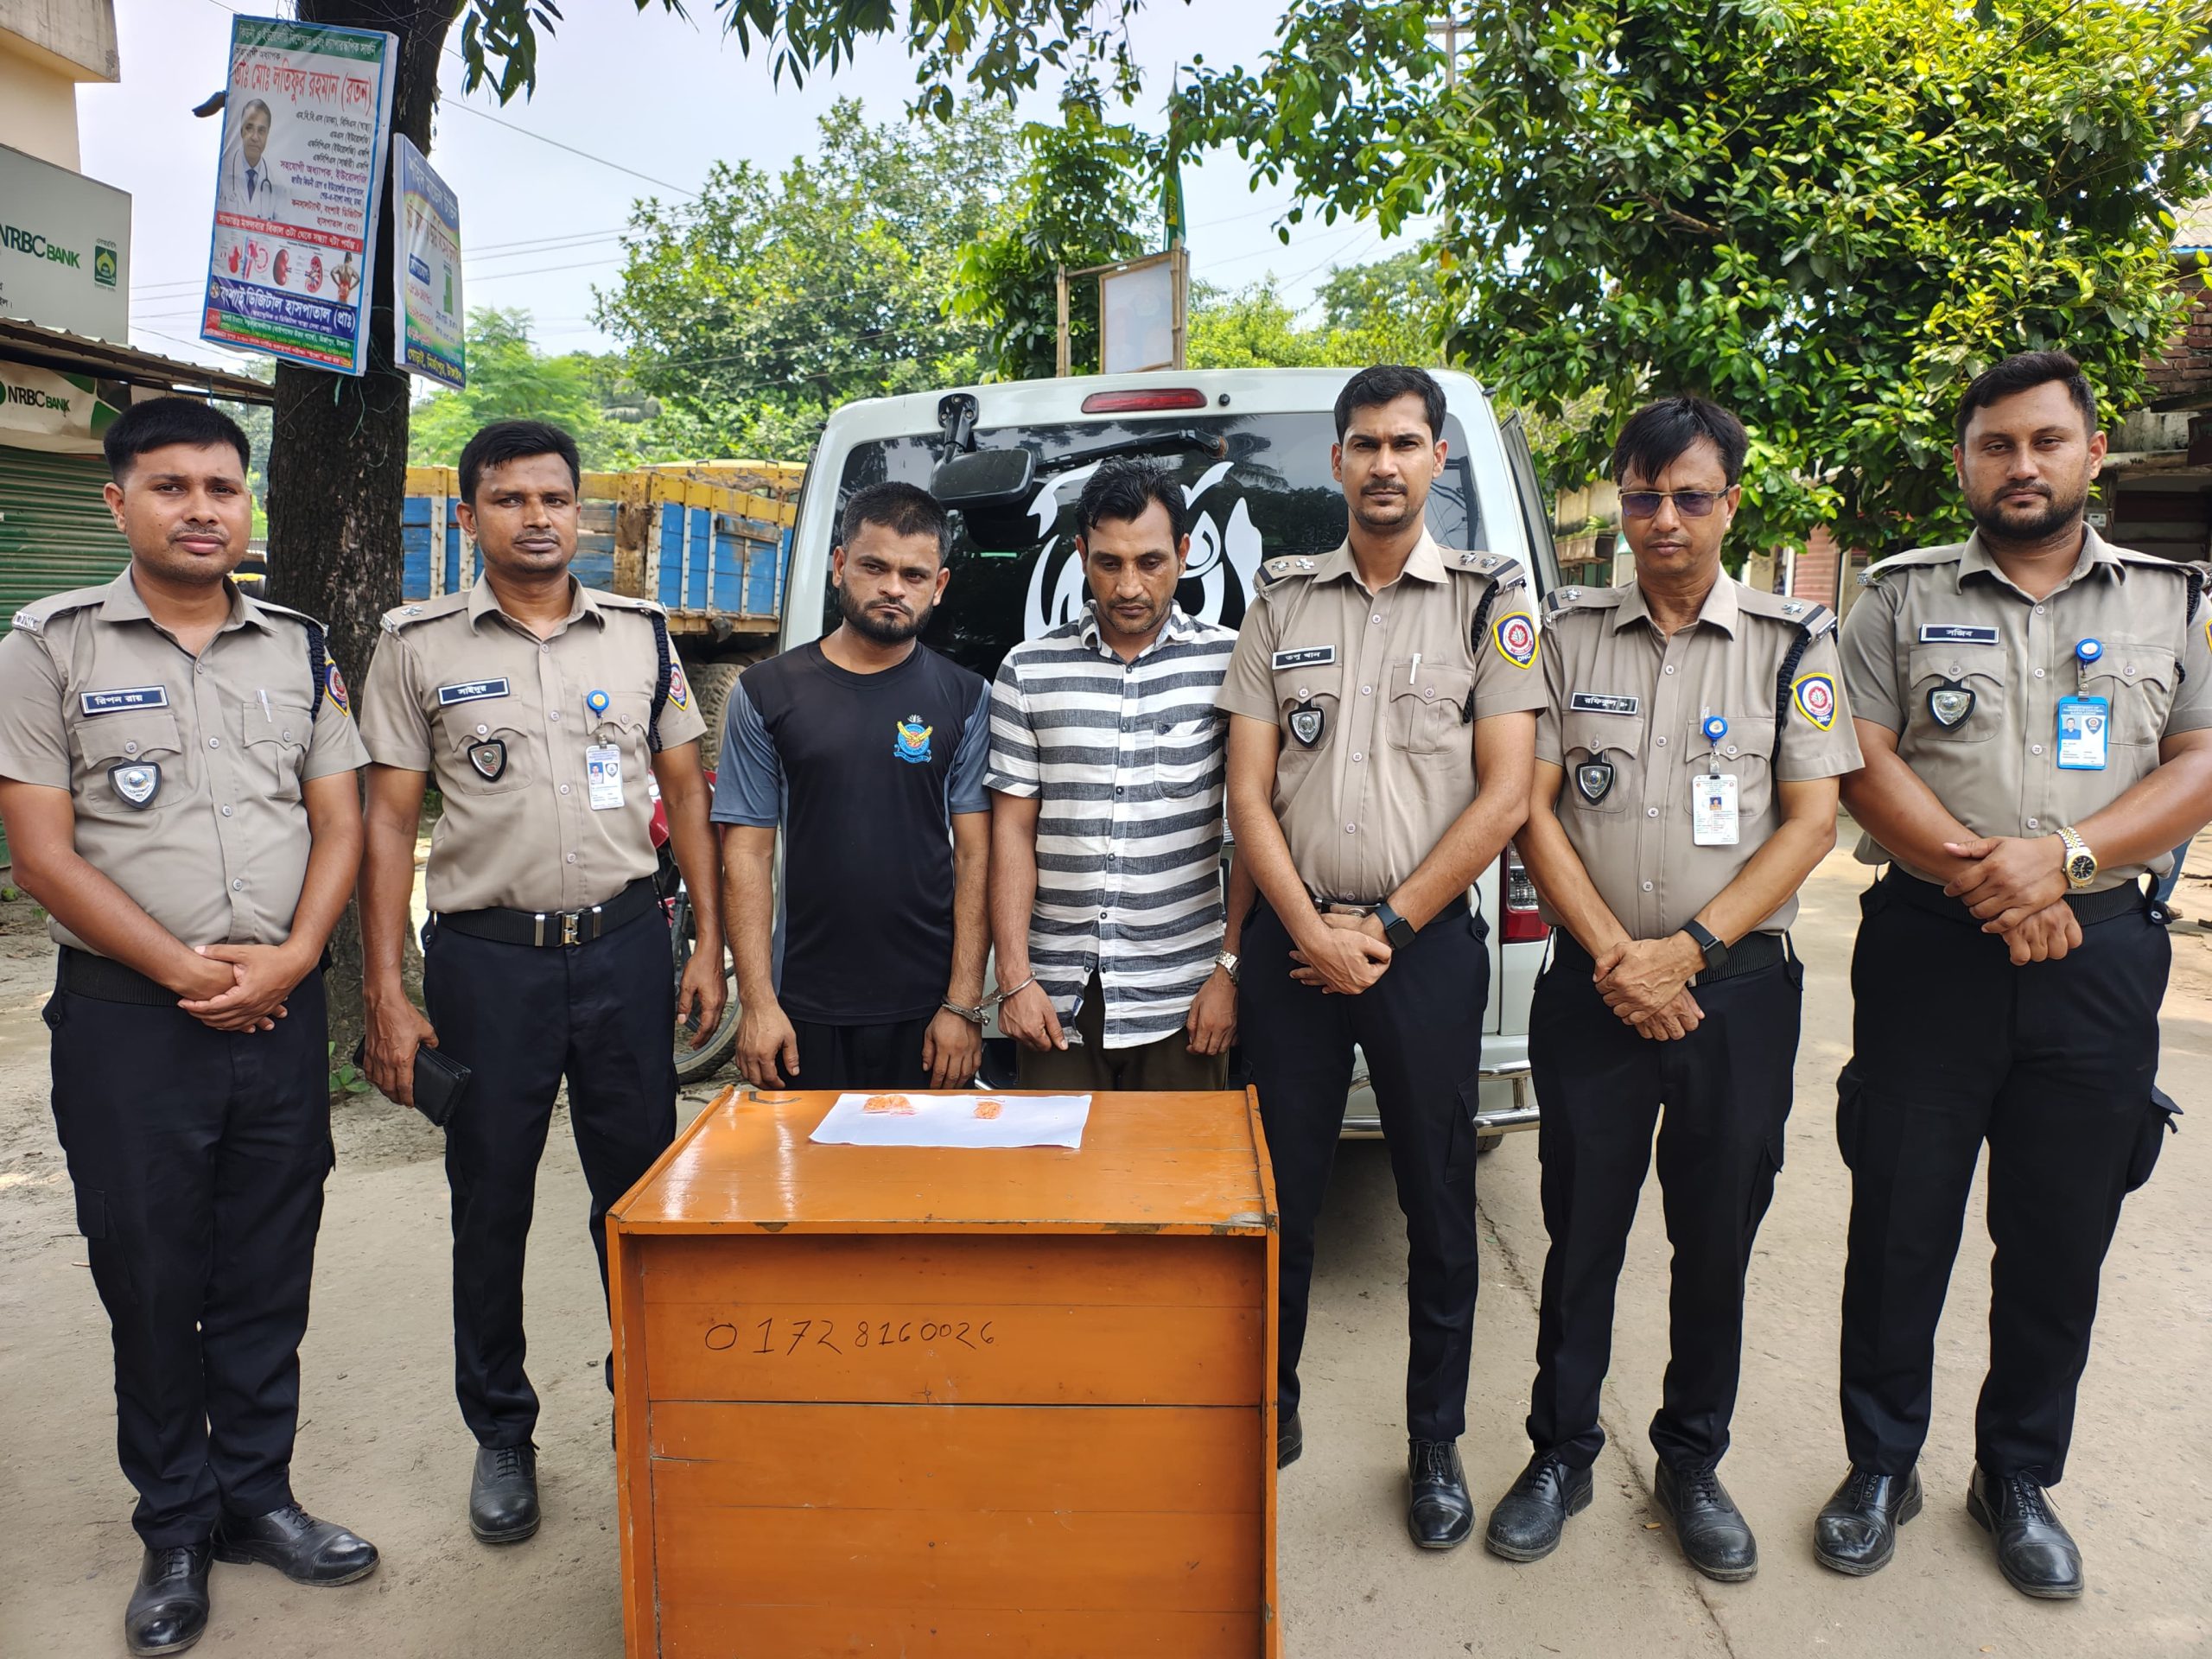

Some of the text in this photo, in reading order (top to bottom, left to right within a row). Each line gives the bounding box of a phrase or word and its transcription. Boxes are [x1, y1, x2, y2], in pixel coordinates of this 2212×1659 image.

[251, 63, 270, 90] মোঃ
[273, 56, 306, 101] লতিফুর
[308, 72, 339, 101] রহমান
[340, 73, 371, 113] (রতন)
[0, 224, 80, 270] NRBC BANK
[246, 287, 282, 310] ডিজিটাল
[285, 300, 330, 321] হাসপাতাল
[334, 310, 355, 331] (প্রাঃ)
[8, 385, 71, 412] NRBC BANK
[95, 695, 143, 706] রিপন রায়
